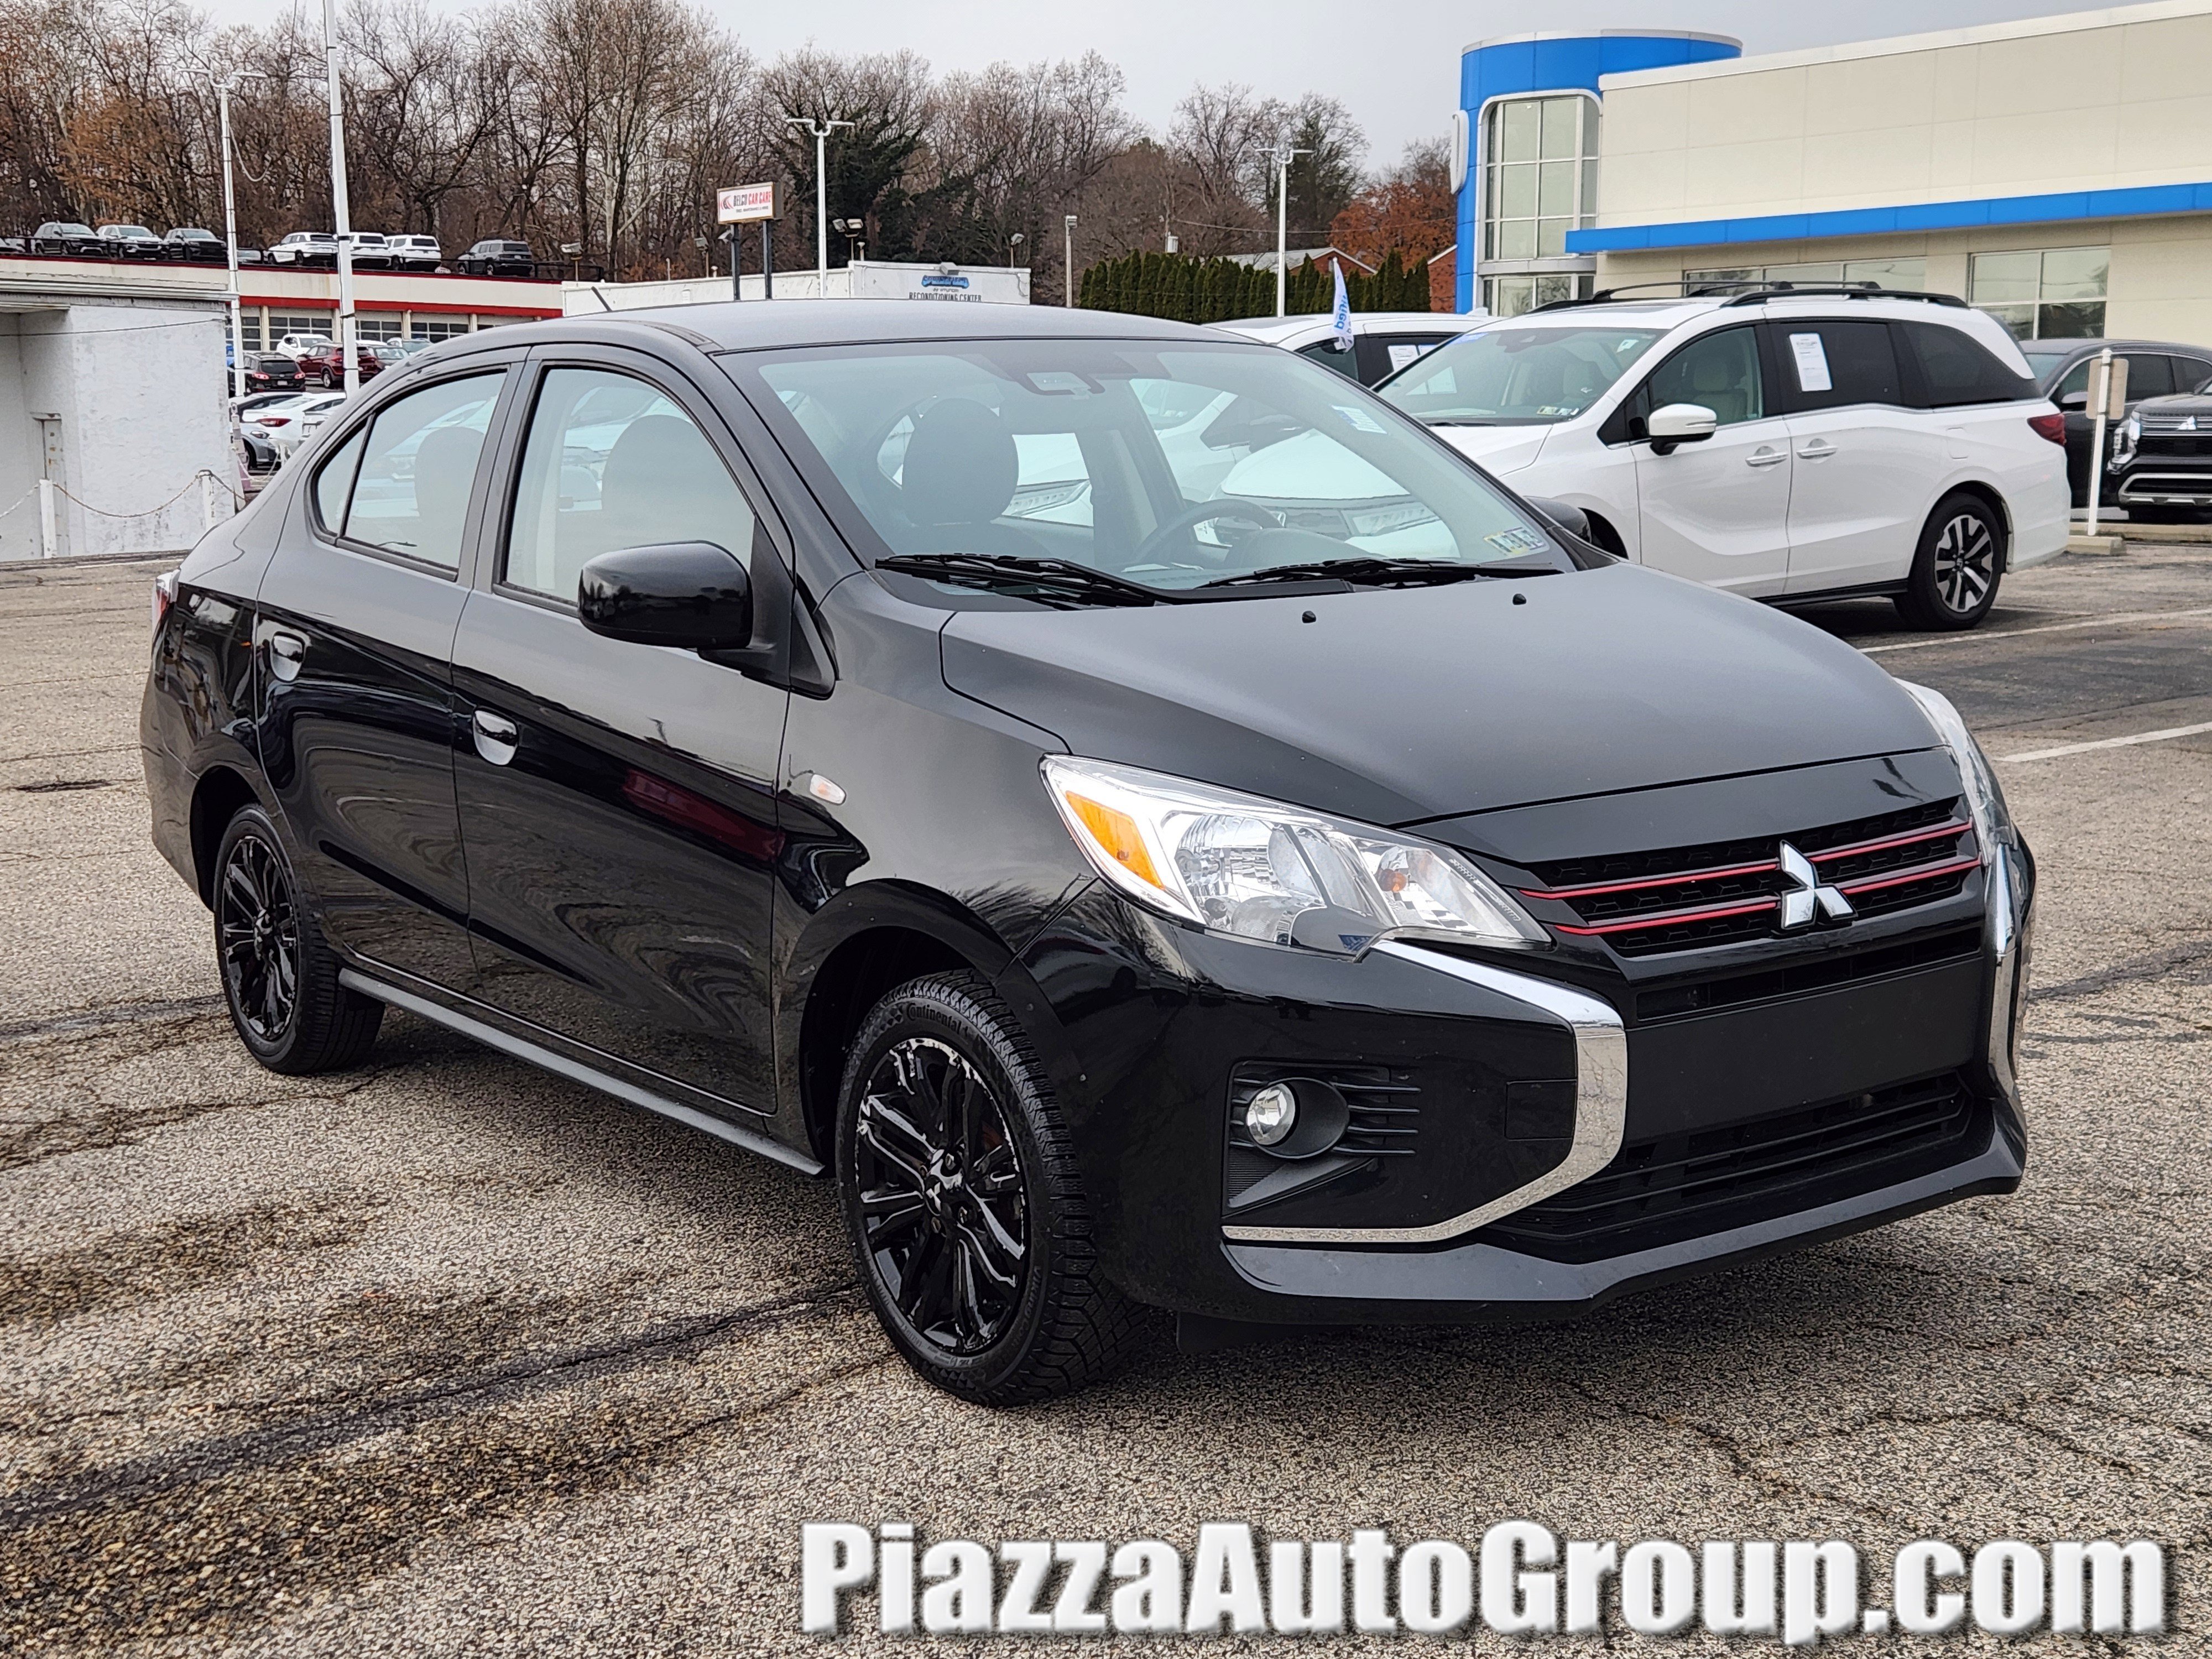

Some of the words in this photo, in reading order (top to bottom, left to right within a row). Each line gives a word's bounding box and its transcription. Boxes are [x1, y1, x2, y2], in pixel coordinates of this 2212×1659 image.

[909, 292, 958, 301] RECONDITIONING
[959, 294, 982, 302] CENTER
[906, 1002, 962, 1035] Continental
